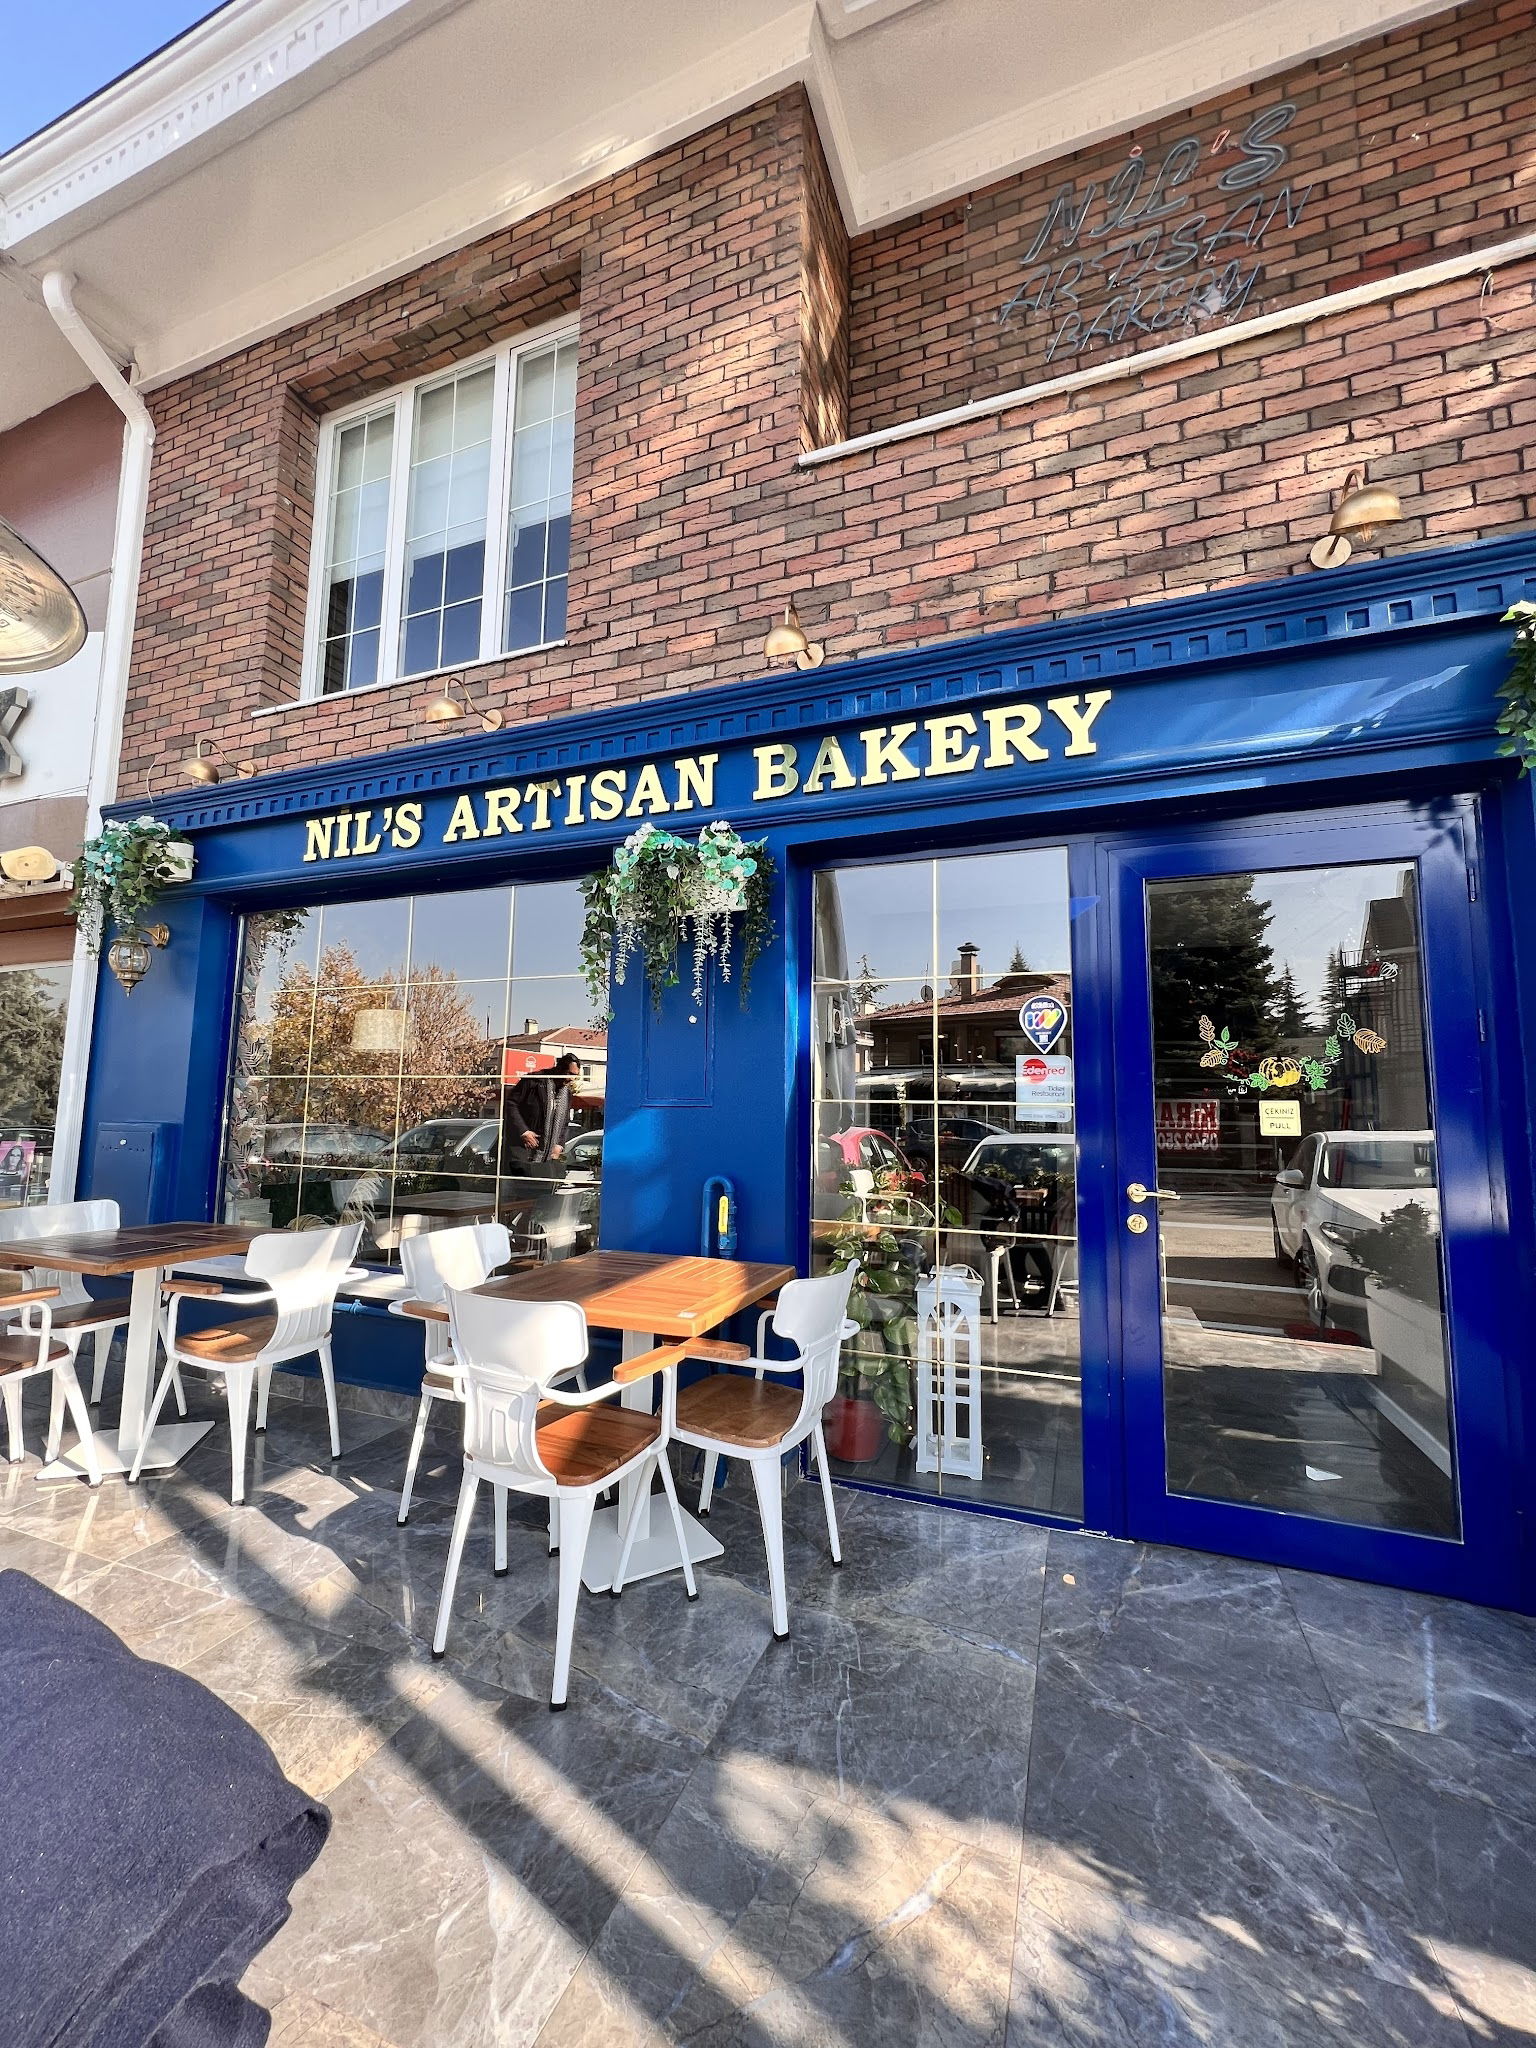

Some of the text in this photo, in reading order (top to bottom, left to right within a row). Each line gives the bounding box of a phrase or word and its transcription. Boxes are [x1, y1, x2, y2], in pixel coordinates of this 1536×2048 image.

[443, 753, 719, 843] ARTISAN
[752, 690, 1112, 801] BAKERY
[1022, 1065, 1066, 1077] Edenred
[1269, 1122, 1292, 1130] PULL
